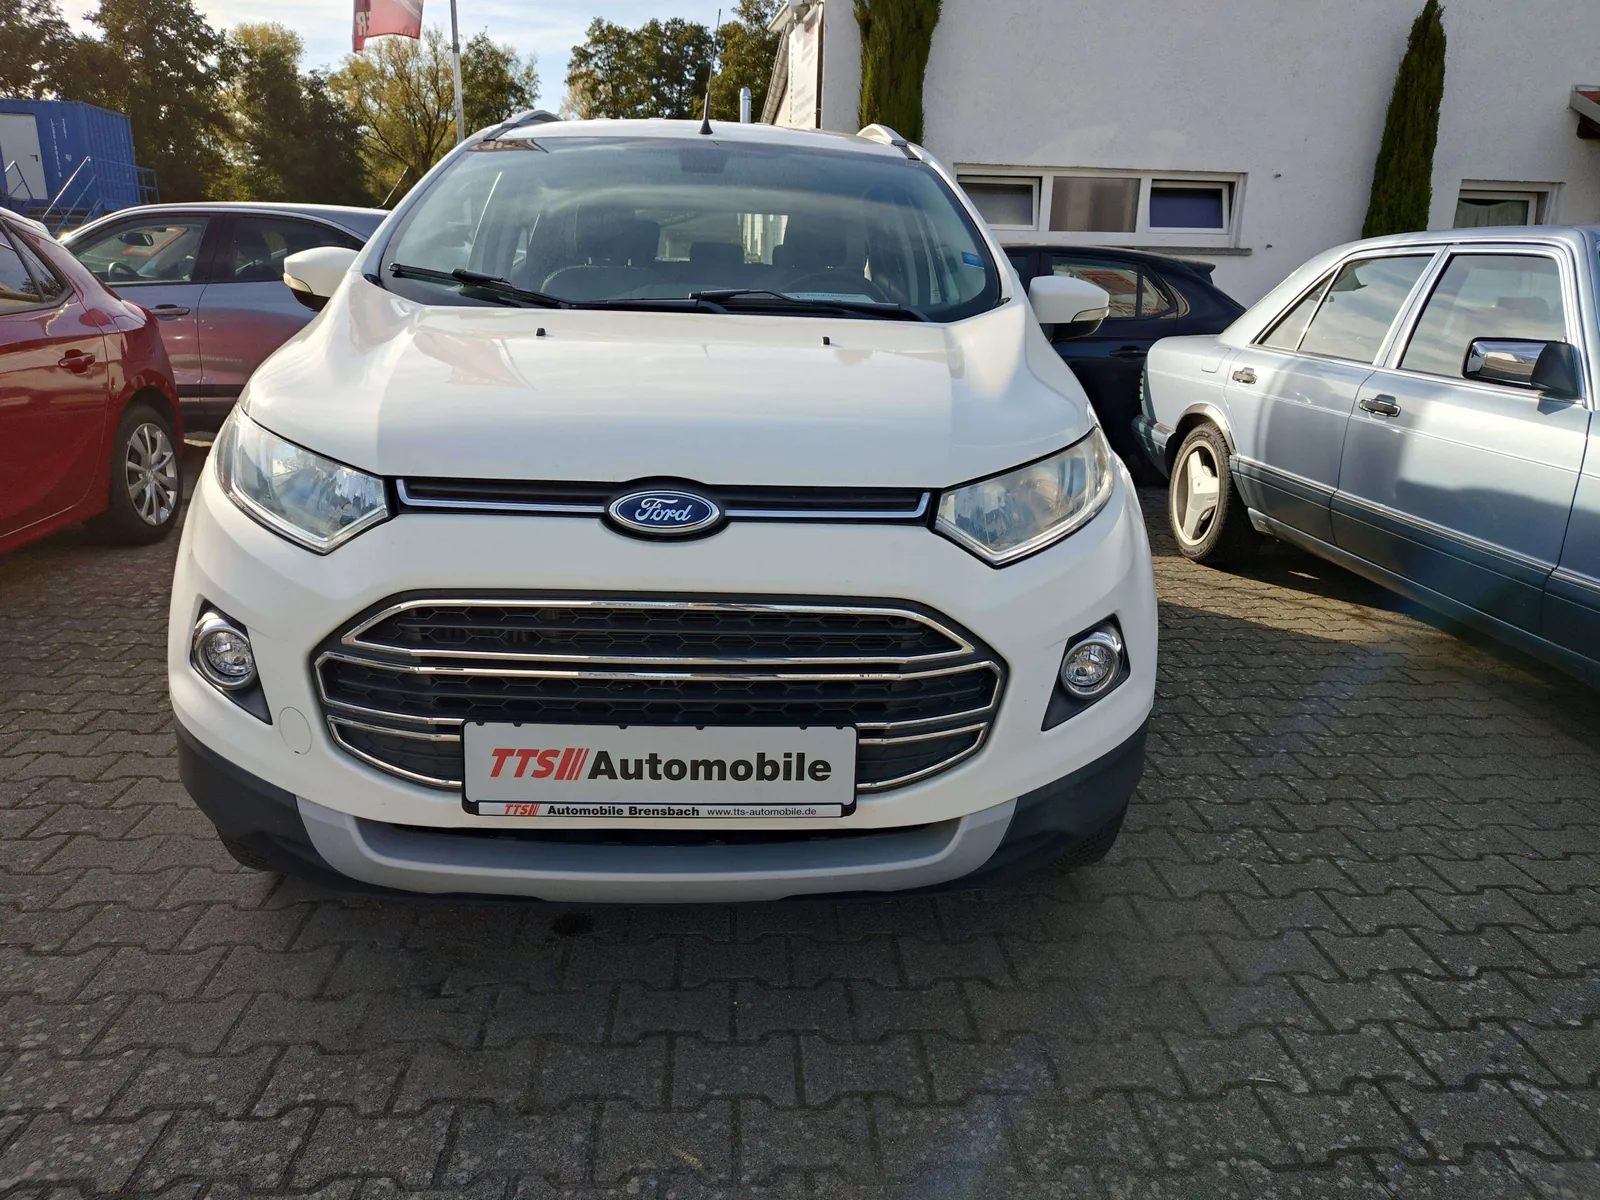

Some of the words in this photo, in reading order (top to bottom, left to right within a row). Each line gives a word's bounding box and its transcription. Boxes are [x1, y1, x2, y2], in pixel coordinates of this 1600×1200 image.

[634, 497, 693, 522] Ford
[490, 748, 561, 779] TTS
[587, 750, 832, 782] Automobile
[504, 804, 531, 815] TTS
[547, 805, 624, 816] Automobile
[628, 806, 700, 817] Brensbach
[707, 807, 817, 818] www.tts-automobile.de
